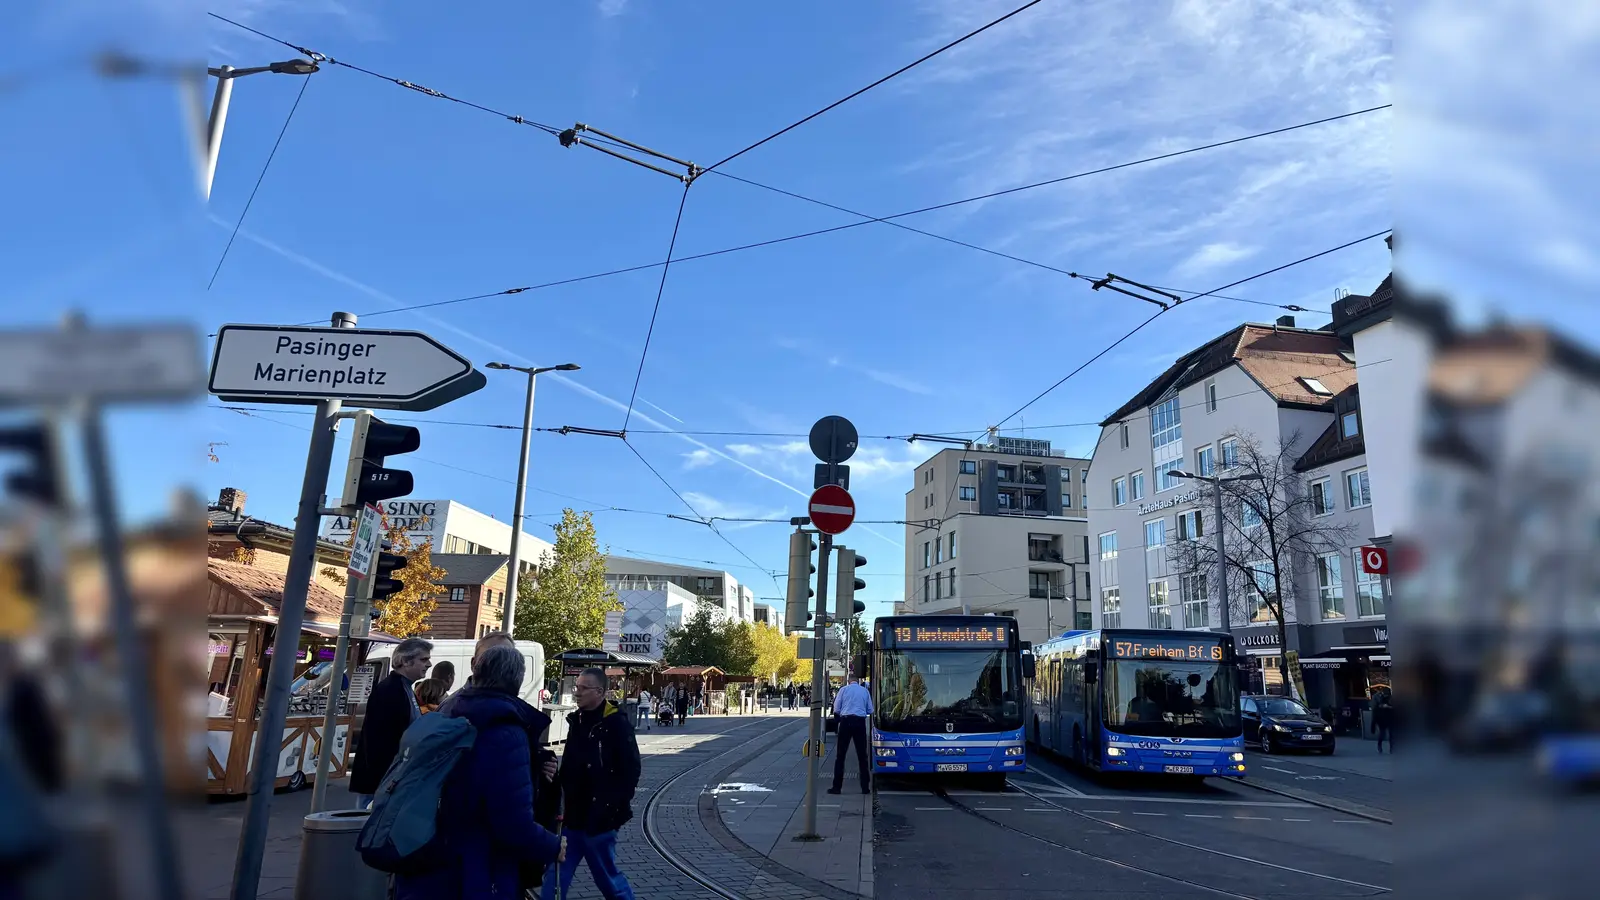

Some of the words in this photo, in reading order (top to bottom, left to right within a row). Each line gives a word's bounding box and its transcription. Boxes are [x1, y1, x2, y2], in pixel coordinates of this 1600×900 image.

[275, 336, 376, 361] Pasinger
[253, 363, 387, 388] Marienplatz
[894, 627, 911, 641] 19
[917, 627, 993, 641] Westendstraße
[1116, 642, 1132, 657] 57
[1134, 644, 1185, 658] Freiham
[1188, 645, 1208, 658] Bf.
